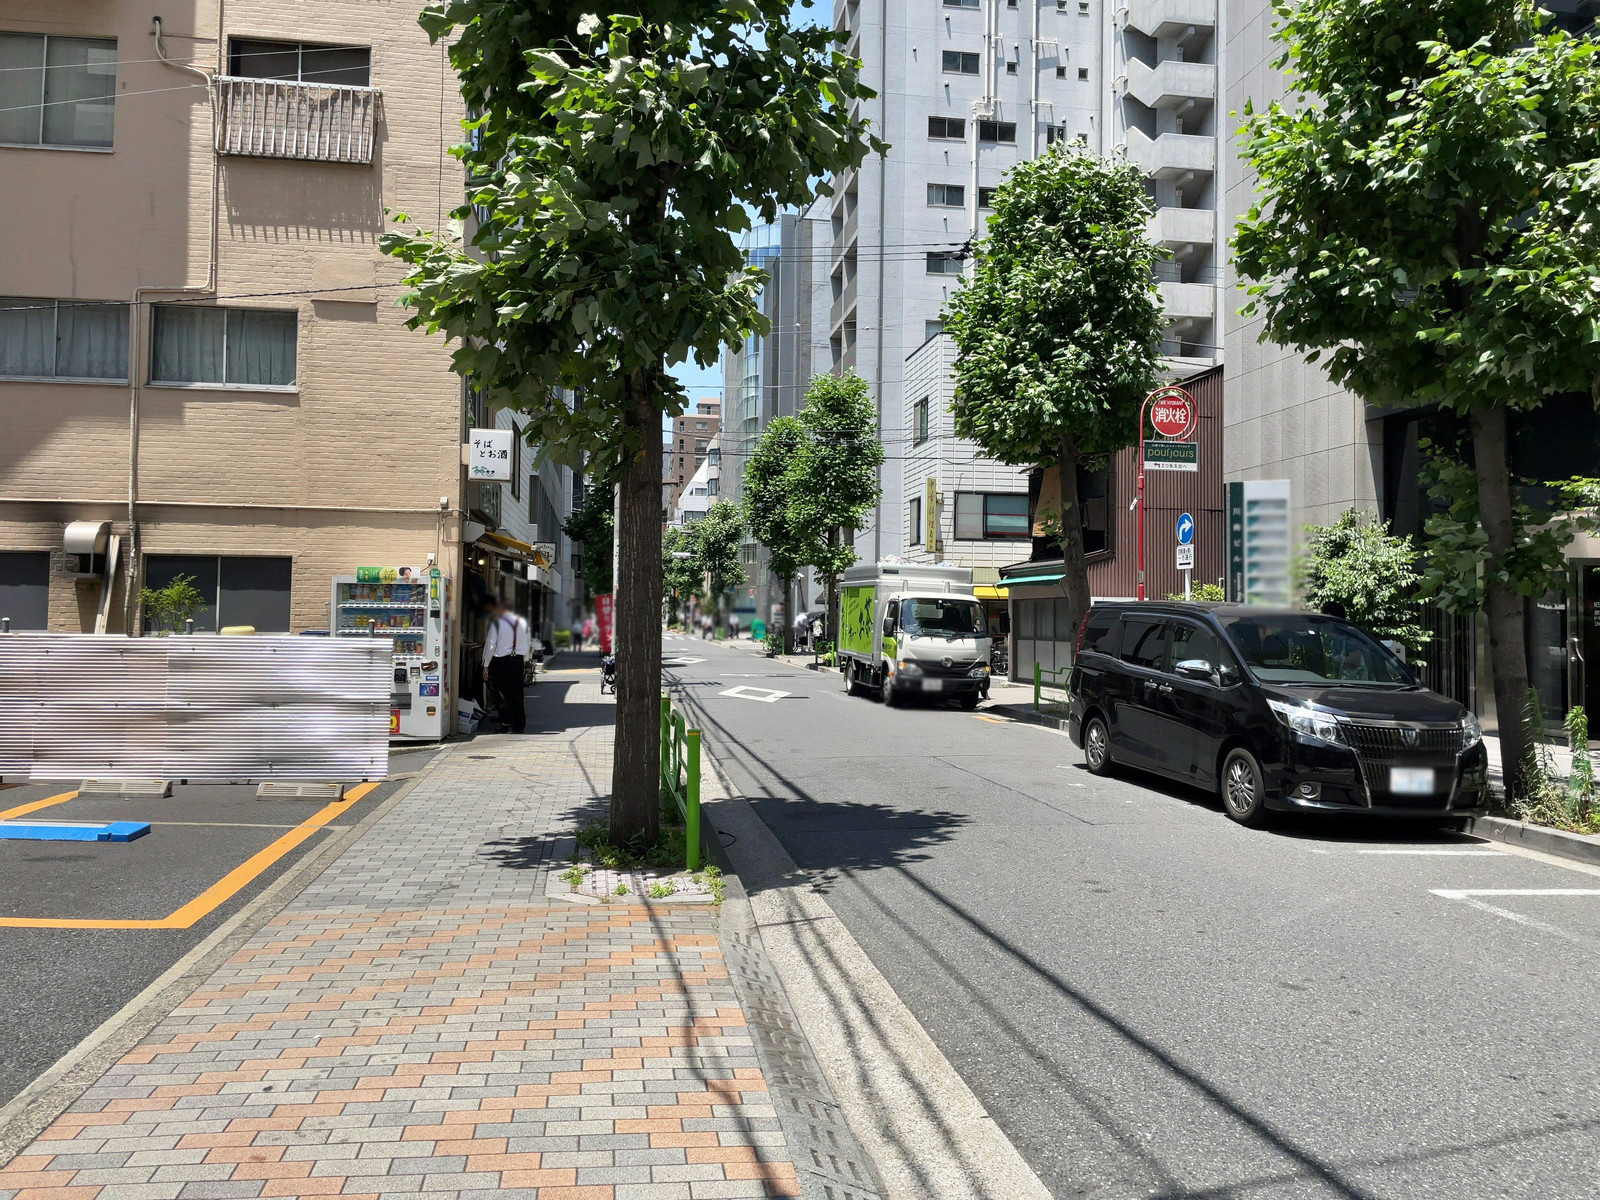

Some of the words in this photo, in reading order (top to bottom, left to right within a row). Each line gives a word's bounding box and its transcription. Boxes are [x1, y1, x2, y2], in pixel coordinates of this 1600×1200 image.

[1155, 408, 1187, 424] 消火栓
[474, 439, 493, 449] そば
[480, 449, 508, 459] とお酒
[382, 568, 395, 582] 新
